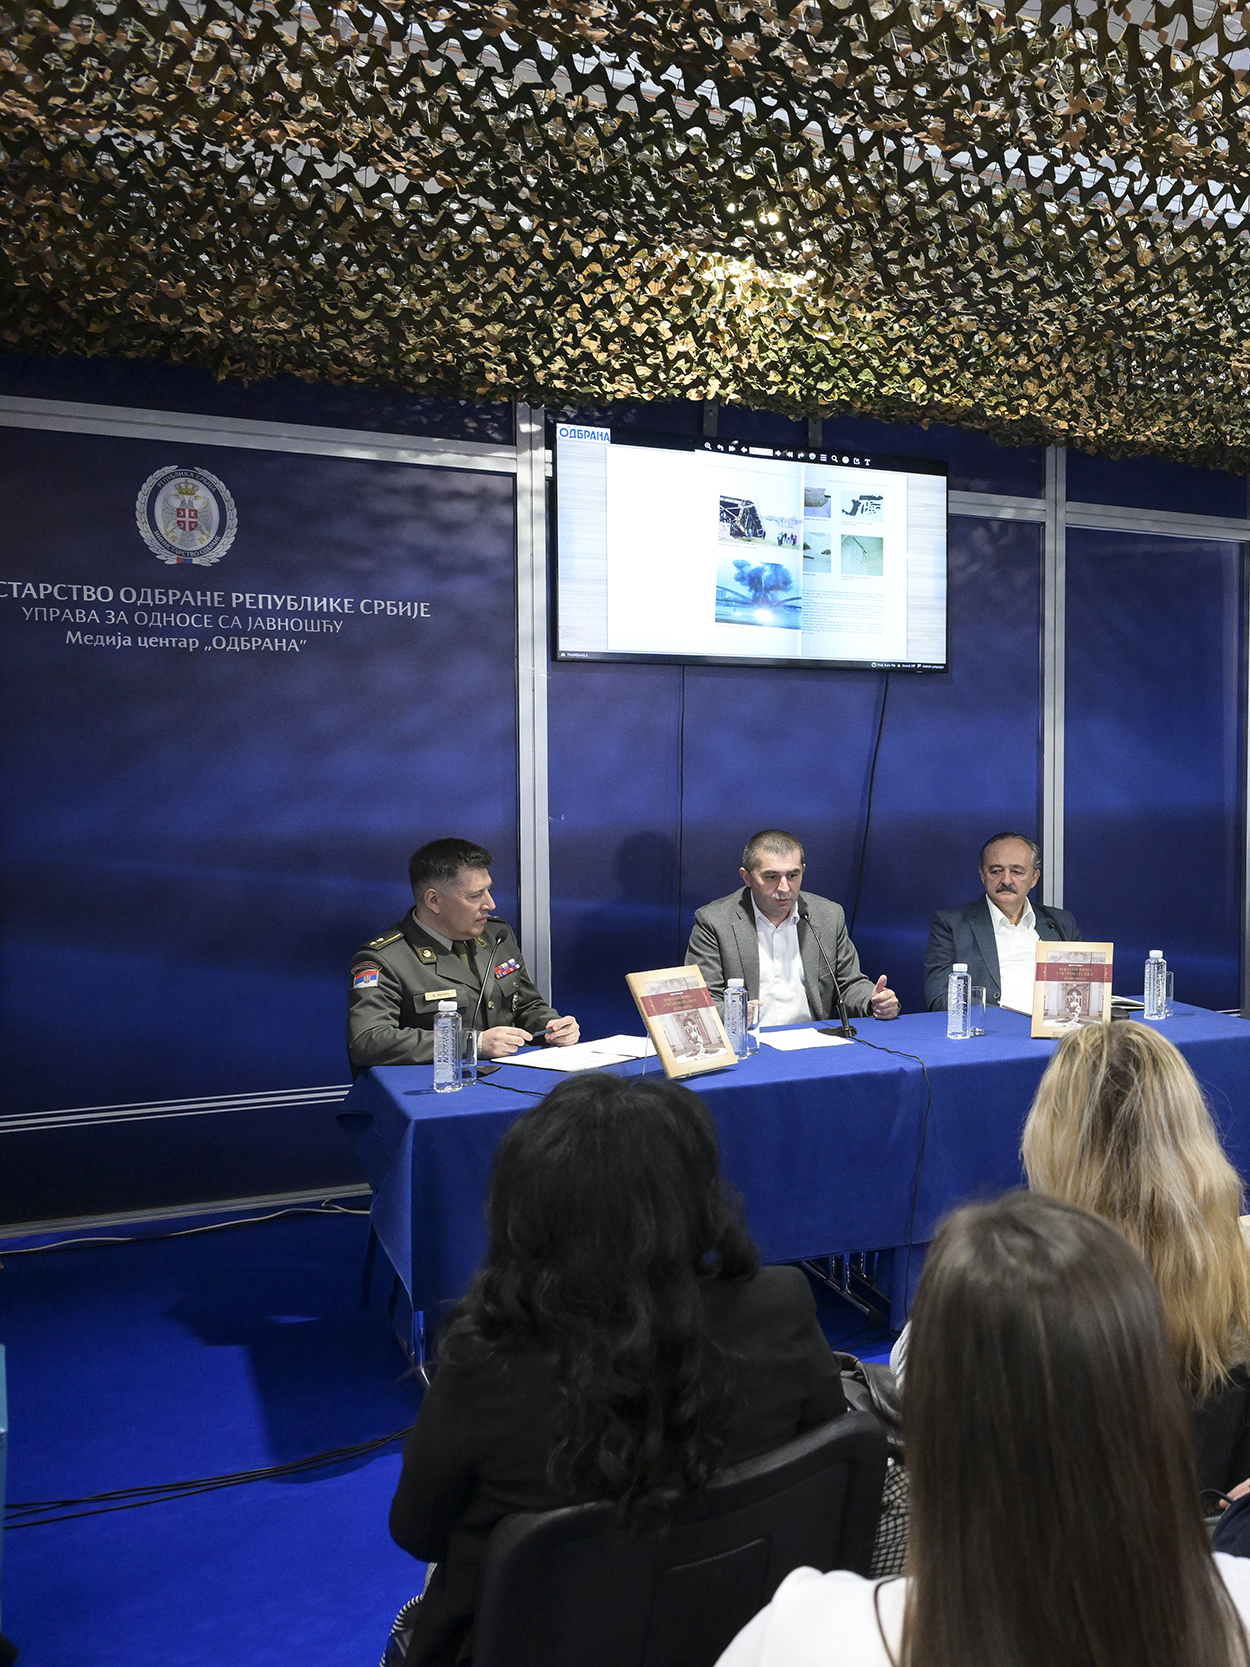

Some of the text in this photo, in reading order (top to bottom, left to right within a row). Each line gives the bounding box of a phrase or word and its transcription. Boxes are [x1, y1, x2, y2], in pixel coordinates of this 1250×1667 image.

[559, 427, 610, 442] ОДБРАНА
[119, 586, 226, 608] ОДБРАНЕ
[231, 592, 355, 614] РЕПУБЛИКЕ
[359, 599, 431, 619] СРБИЈЕ
[21, 606, 344, 633] УПРАВА ЗА ОДНОСЕ СА ЈАВНОШЋУ
[65, 630, 132, 650] Медија
[138, 634, 199, 652] центар
